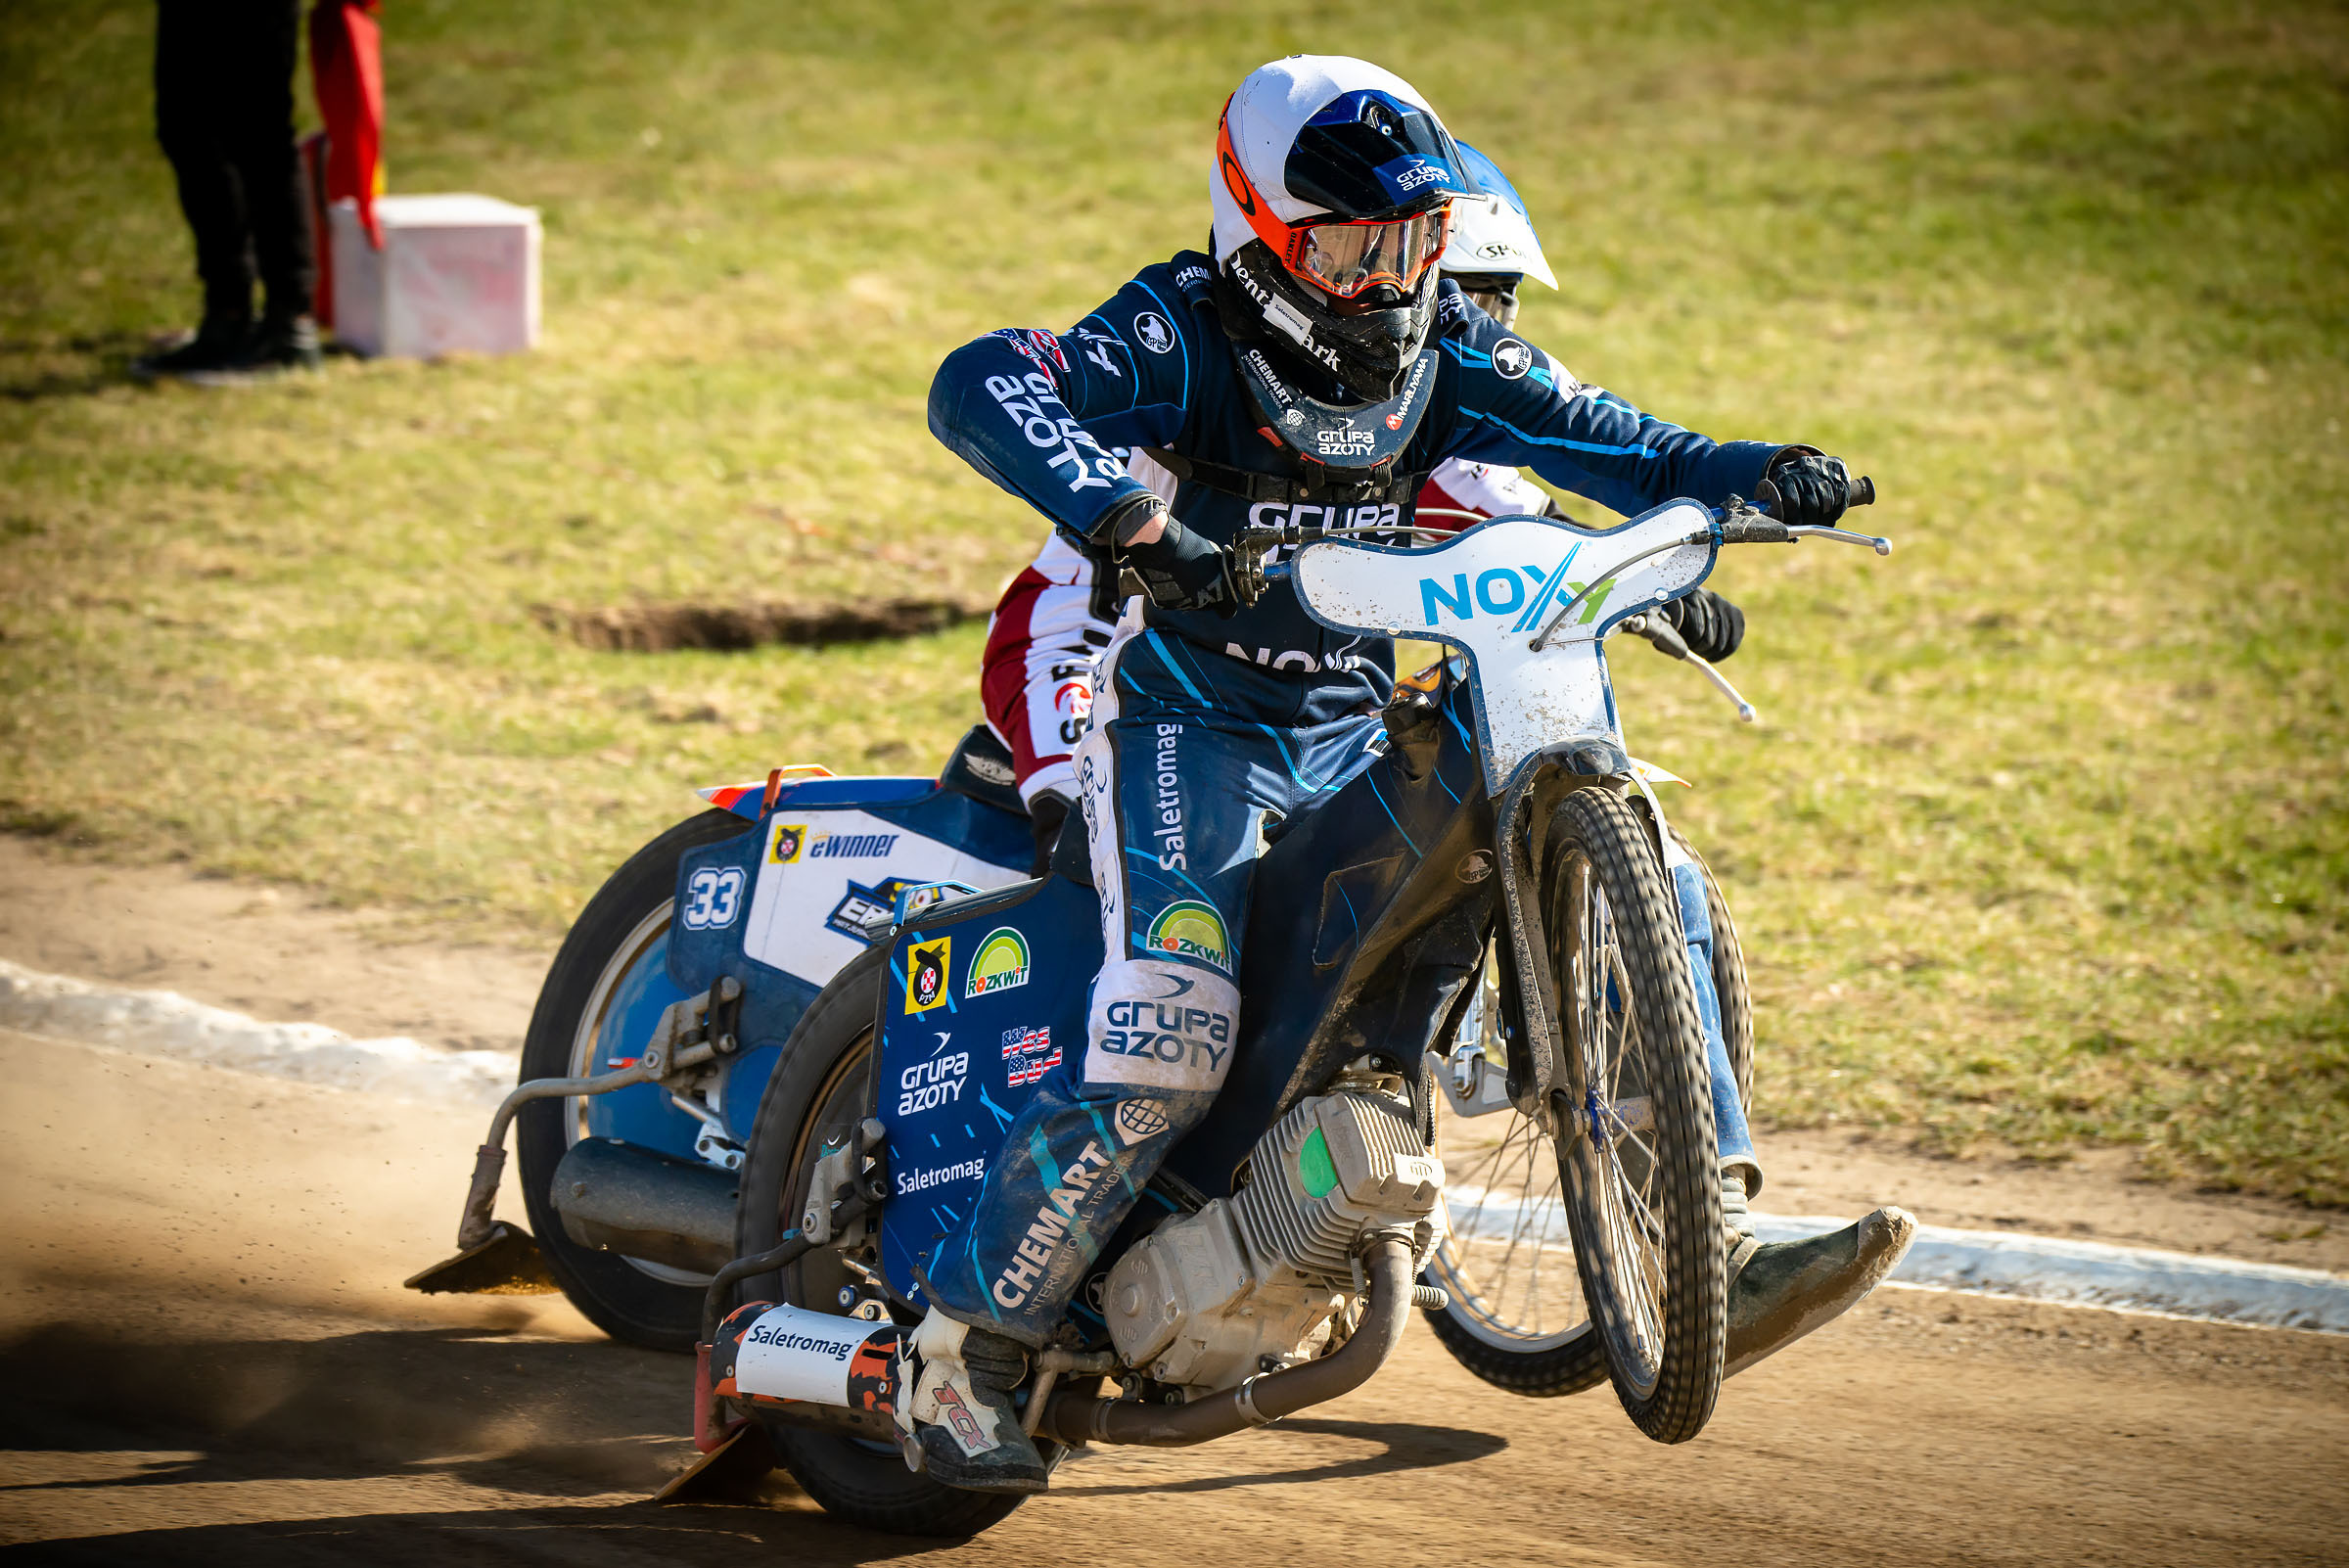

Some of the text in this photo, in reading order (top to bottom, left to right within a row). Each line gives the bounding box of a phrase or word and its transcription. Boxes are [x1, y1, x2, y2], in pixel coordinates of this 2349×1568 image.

[1284, 232, 1297, 263] OAKLEY
[1249, 348, 1292, 404] CHEMART
[1396, 358, 1429, 420] MARUYAMA
[1418, 540, 1618, 633] NOXY
[1153, 723, 1187, 871] Saletromag
[684, 866, 748, 931] 33
[918, 992, 937, 1005] PZM
[1001, 1026, 1051, 1061] Wes
[1007, 1046, 1064, 1088] Bud
[897, 1158, 986, 1196] Saletromag
[992, 1140, 1113, 1310] CHEMART
[1023, 1155, 1135, 1317] INTERNATIONAL TRADER
[747, 1324, 853, 1362] Saletromag
